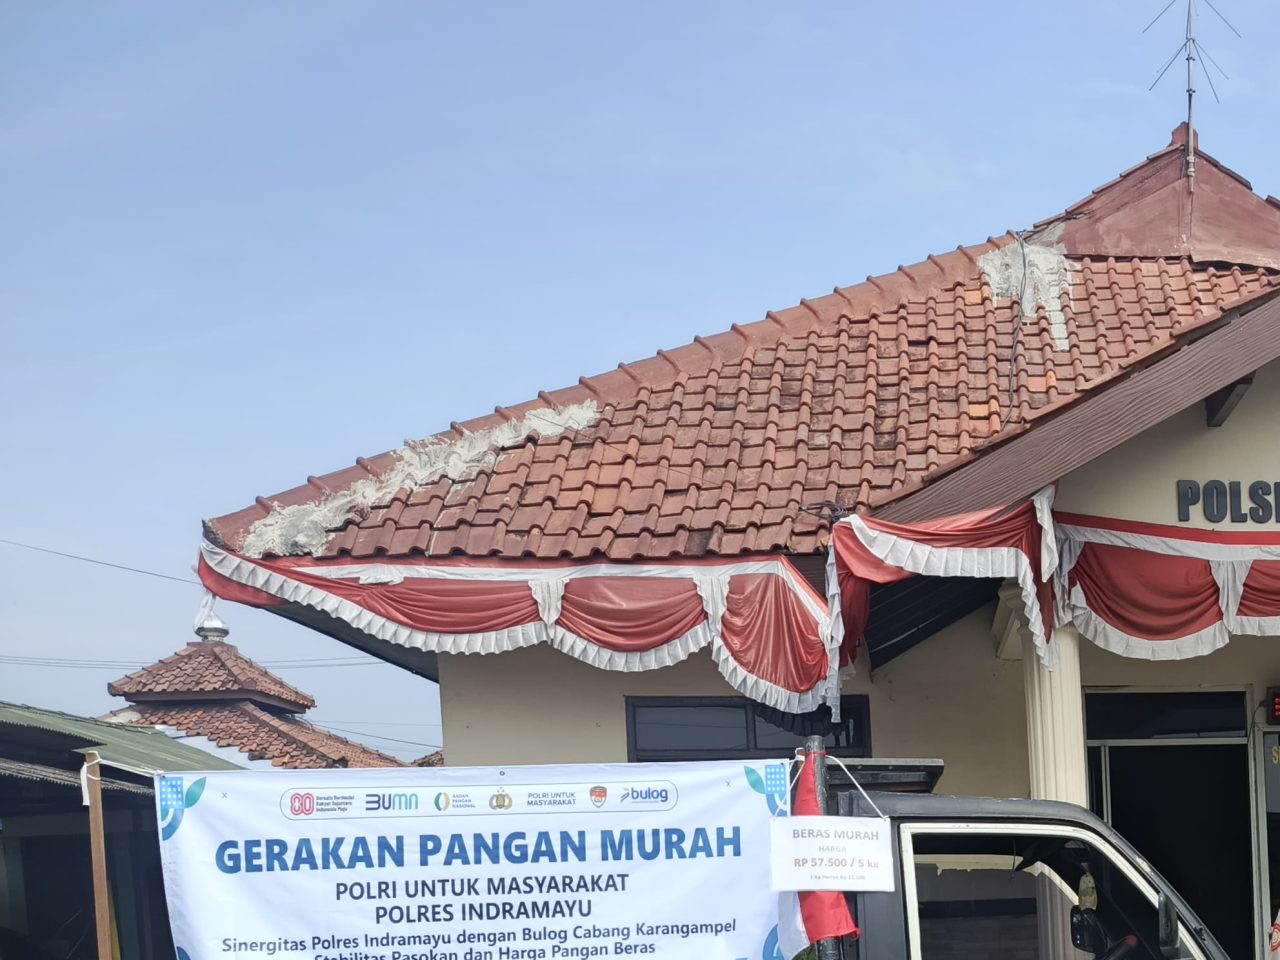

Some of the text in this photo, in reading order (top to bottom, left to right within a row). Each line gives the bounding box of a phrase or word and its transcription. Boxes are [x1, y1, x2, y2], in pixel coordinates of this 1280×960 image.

[631, 787, 668, 802] bulog
[792, 829, 879, 841] BERAS MURAH
[215, 827, 741, 874] GERAKAN PANGAN MURAH
[794, 858, 808, 868] RP
[811, 858, 847, 868] 57.500
[858, 859, 865, 868] 5
[336, 874, 629, 900] POLRI UNTUK MASYARAKAT
[376, 900, 592, 924] POLRES INDRAMAYU
[222, 919, 736, 955] Sinergitas Polres Indramayu dengan Bulog Cabang Karangampel
[551, 943, 609, 960] Pangan
[614, 940, 656, 955] Beras
